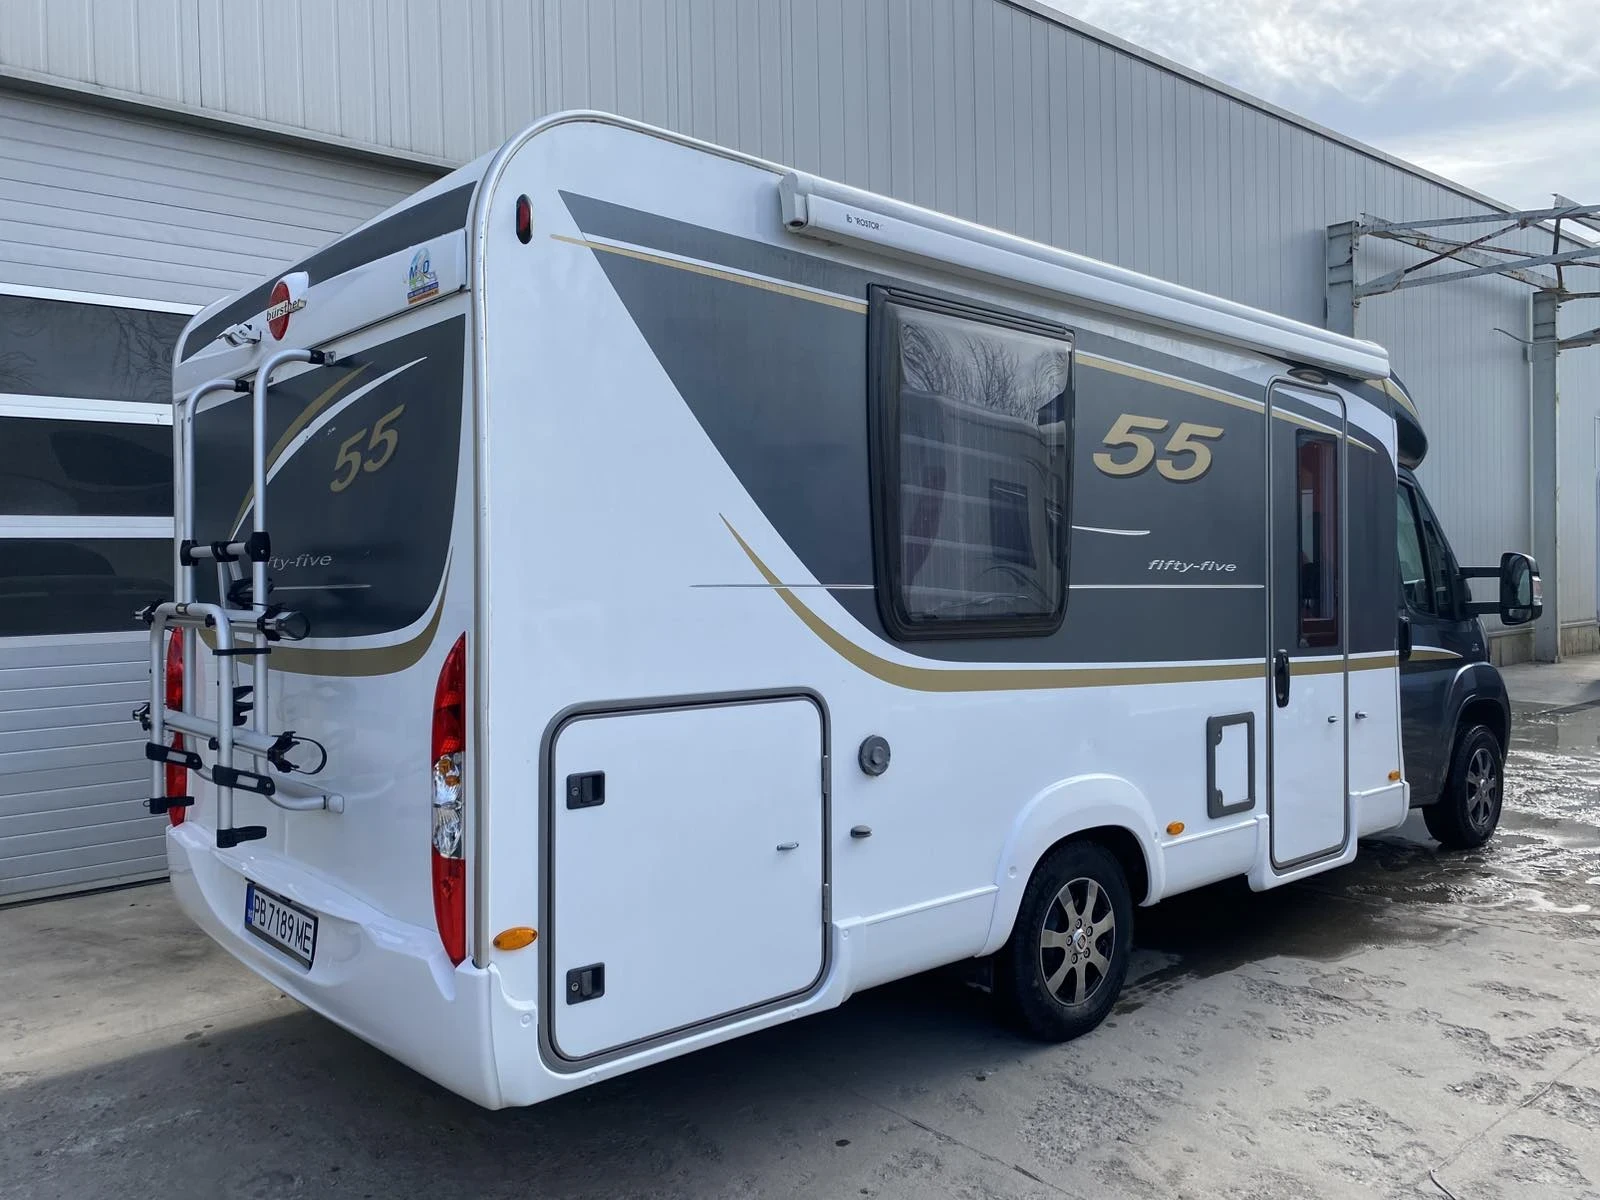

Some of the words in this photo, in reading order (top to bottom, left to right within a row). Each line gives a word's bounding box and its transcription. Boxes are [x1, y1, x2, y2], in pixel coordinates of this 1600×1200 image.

[854, 216, 880, 230] ROSTOR
[331, 404, 405, 492] 55
[1092, 413, 1225, 482] 55
[268, 554, 332, 571] fty-five
[1147, 559, 1237, 573] fifty-five
